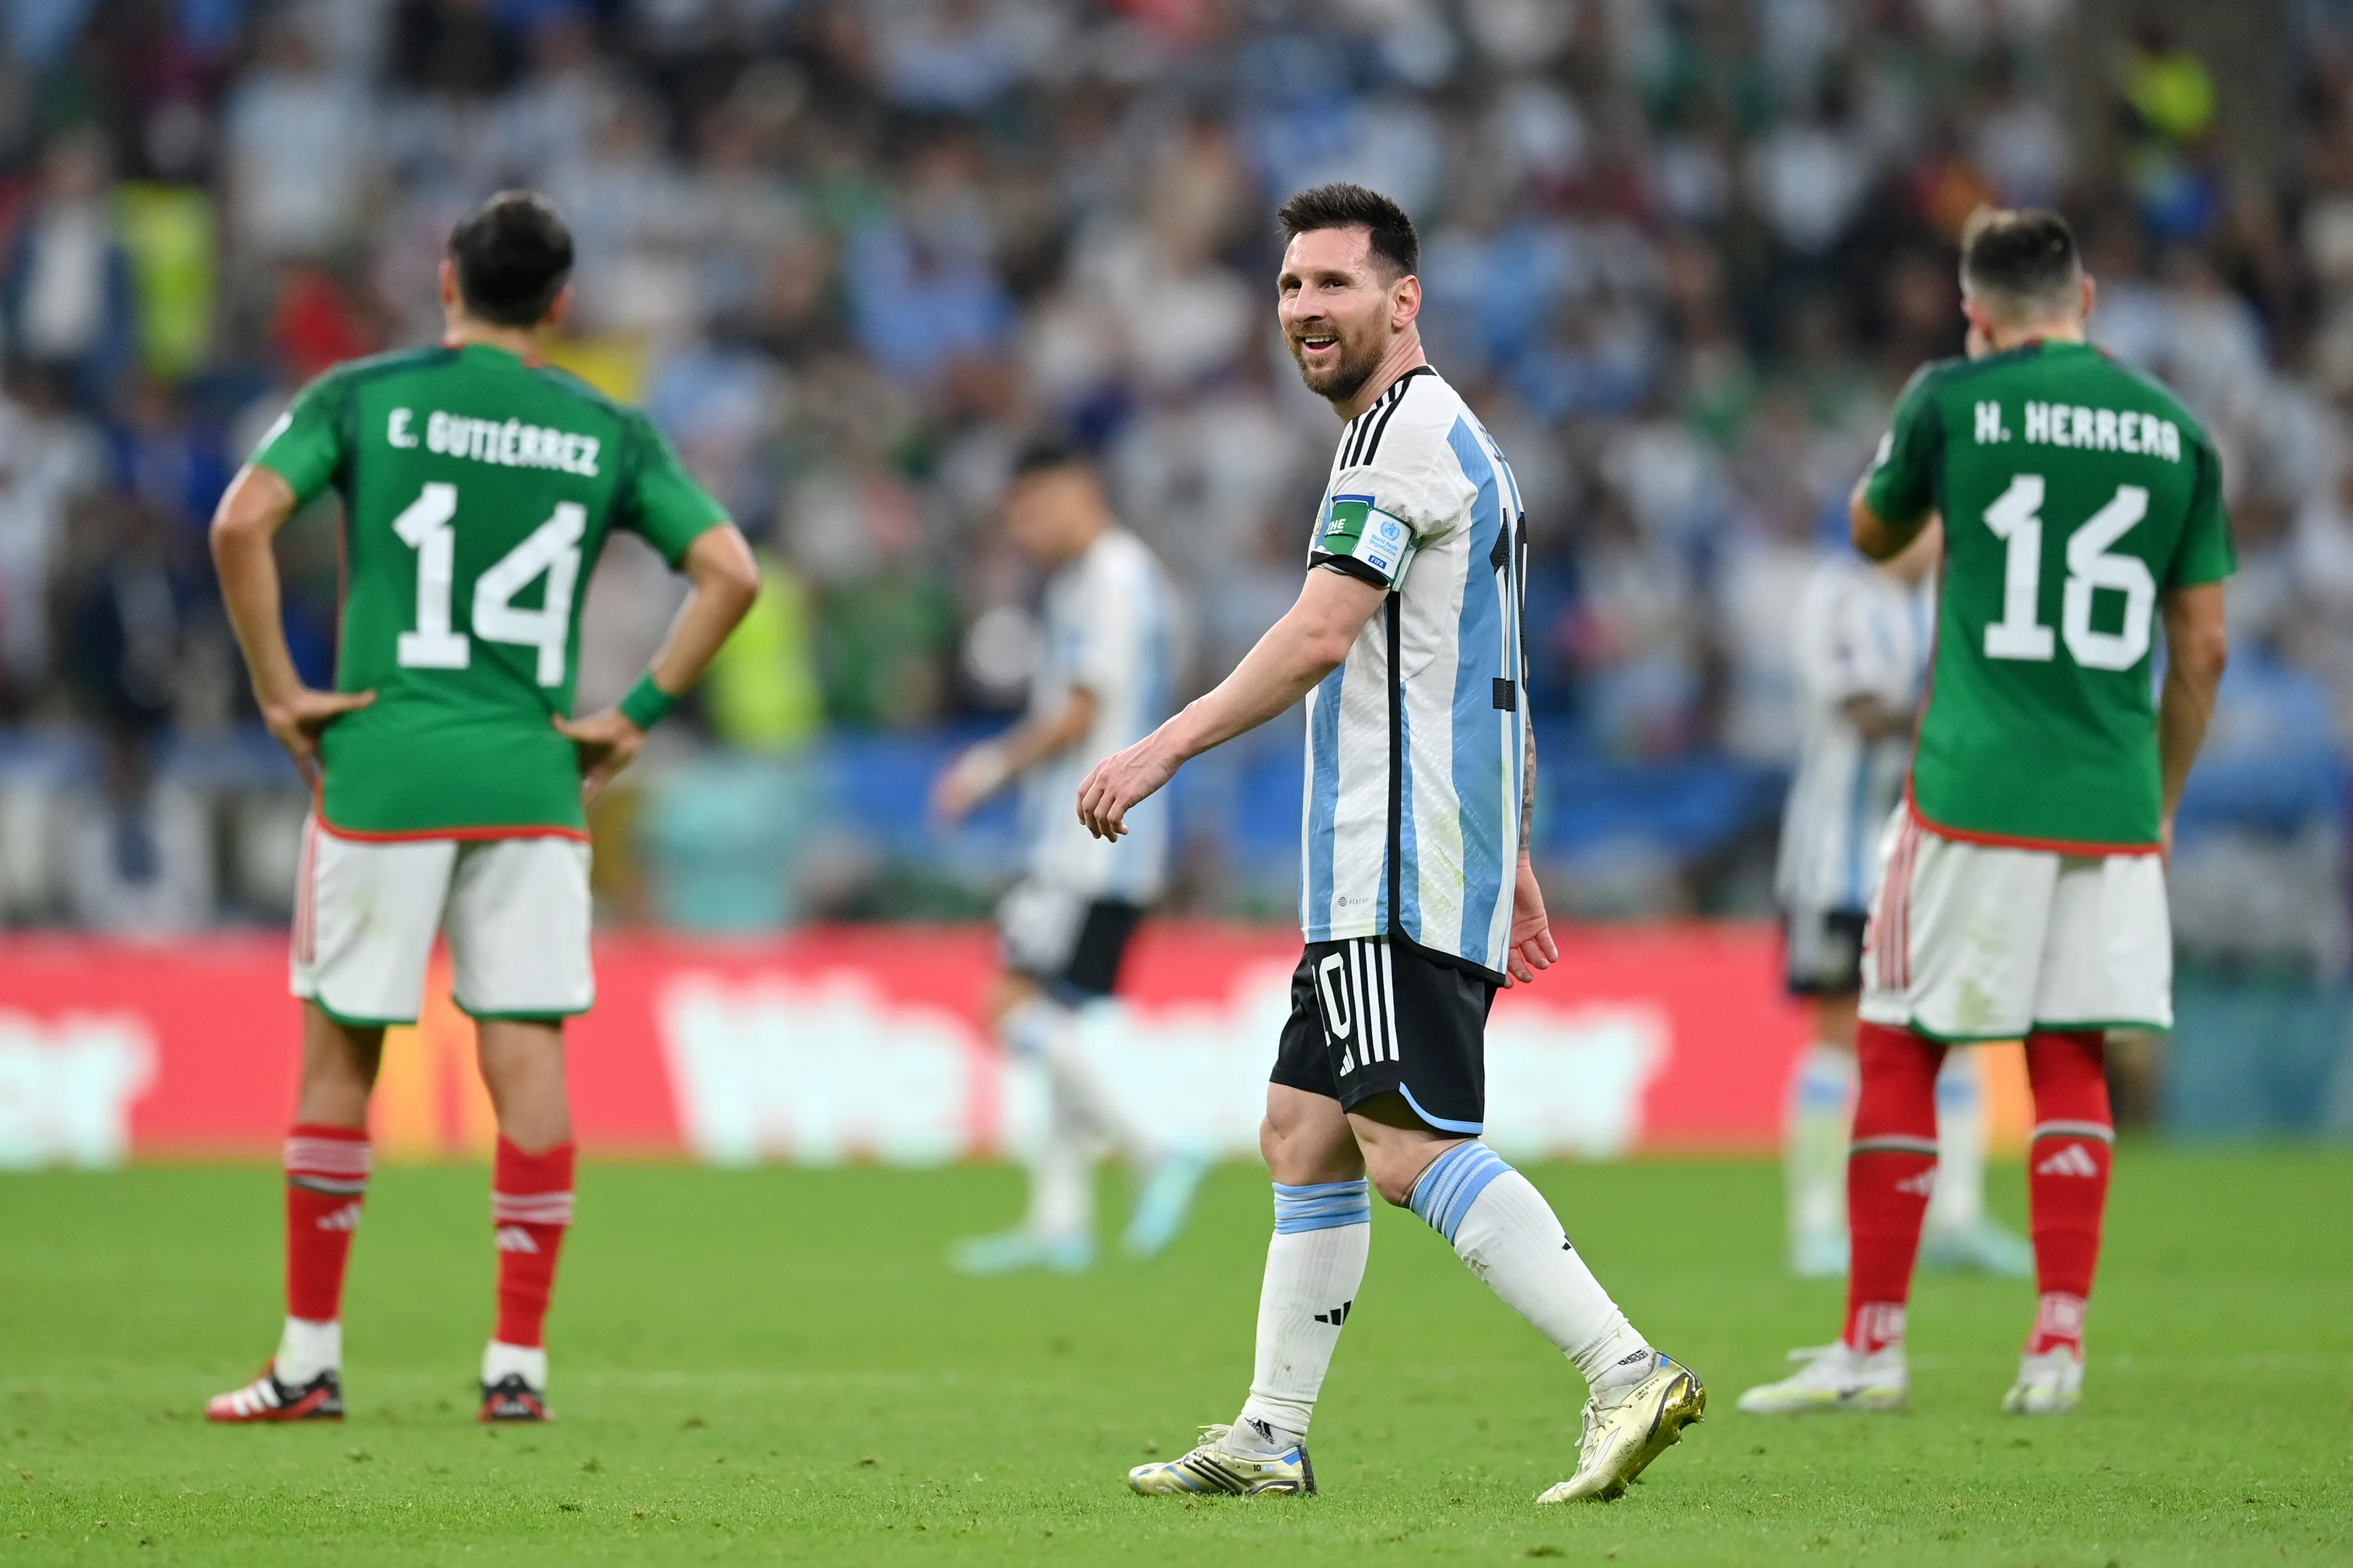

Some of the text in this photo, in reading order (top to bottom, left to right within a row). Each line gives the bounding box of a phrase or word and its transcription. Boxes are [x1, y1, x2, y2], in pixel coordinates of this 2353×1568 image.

[387, 407, 601, 477] E. GUTIÉRREZ
[1974, 400, 2181, 464] H. HERRERA
[1370, 556, 1384, 567] FIFA
[1372, 533, 1385, 545] World
[392, 482, 588, 688] 14
[1981, 474, 2157, 672] 16
